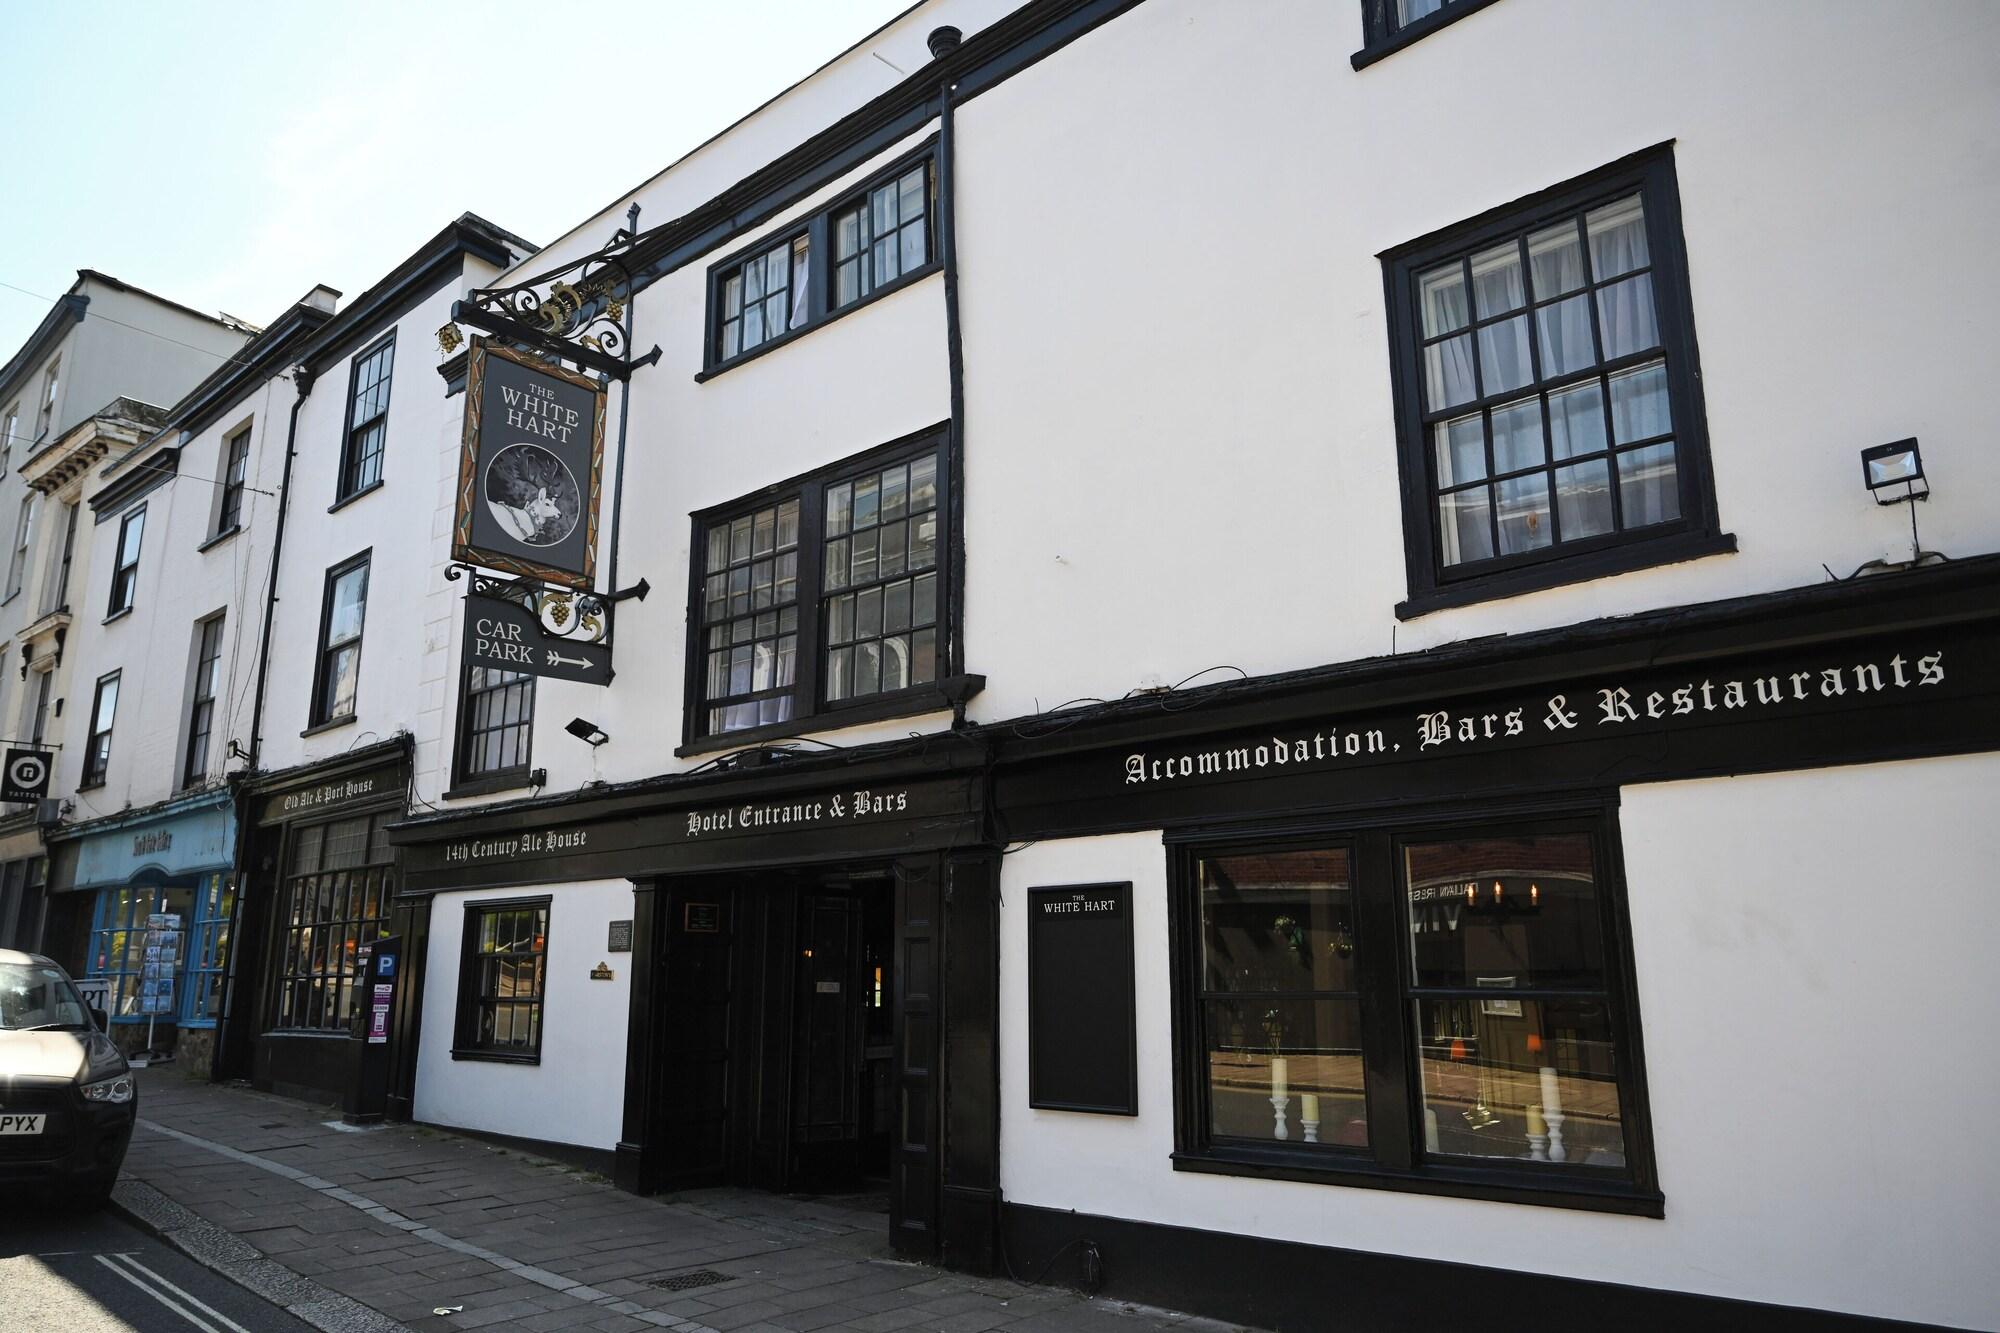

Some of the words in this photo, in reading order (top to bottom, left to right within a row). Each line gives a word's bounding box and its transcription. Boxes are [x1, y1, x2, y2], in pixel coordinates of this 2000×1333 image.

[529, 383, 555, 400] THE
[501, 386, 579, 428] WHITE
[507, 408, 572, 443] HART
[476, 618, 522, 642] CAR
[474, 638, 534, 664] PARK
[1125, 727, 1402, 785] Accommodation,
[1417, 708, 1524, 751] Bars
[1543, 694, 1578, 730] &
[1597, 650, 1946, 725] Restaurants
[284, 795, 299, 810] Old
[300, 792, 314, 806] Ale
[315, 789, 322, 803] &
[324, 786, 344, 804] Port
[345, 779, 373, 799] House
[686, 808, 733, 837] Hotel
[739, 801, 822, 828] Entrance
[829, 794, 846, 818] &
[853, 790, 907, 819] Bars
[446, 843, 468, 862] 14th
[471, 840, 518, 859] Century
[520, 834, 542, 854] Ale
[545, 830, 587, 854] House
[1044, 901, 1080, 913] WHITE
[1084, 900, 1115, 912] HART
[379, 957, 393, 974] P
[0, 1116, 38, 1132] PYX
